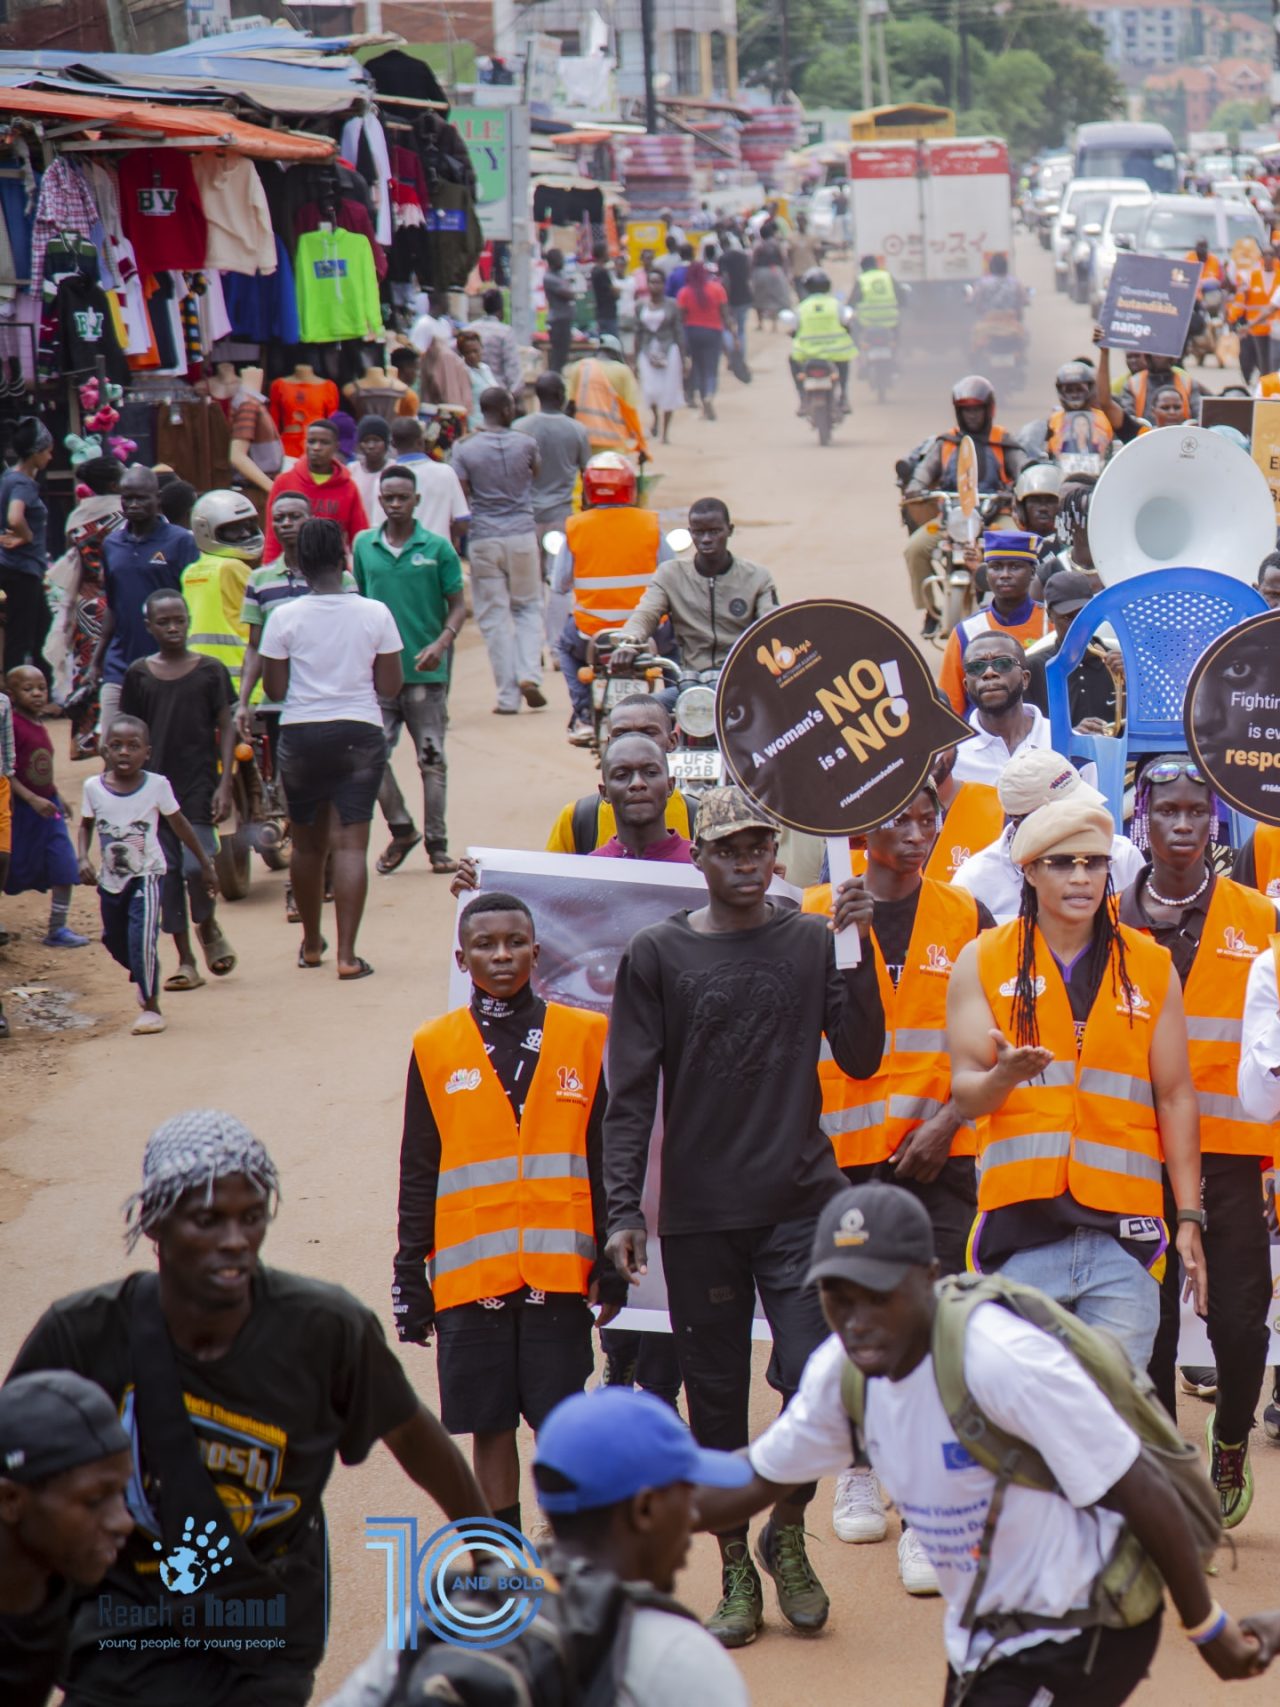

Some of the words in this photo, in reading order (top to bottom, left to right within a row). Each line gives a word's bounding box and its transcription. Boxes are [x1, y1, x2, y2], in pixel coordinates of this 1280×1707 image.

[1110, 320, 1151, 338] nange
[614, 681, 641, 694] UES
[751, 751, 766, 769] A
[764, 708, 825, 759] woman's
[817, 755, 837, 772] is
[831, 746, 848, 761] a
[840, 695, 911, 764] NO
[1248, 723, 1262, 739] is
[683, 753, 715, 765] UFS
